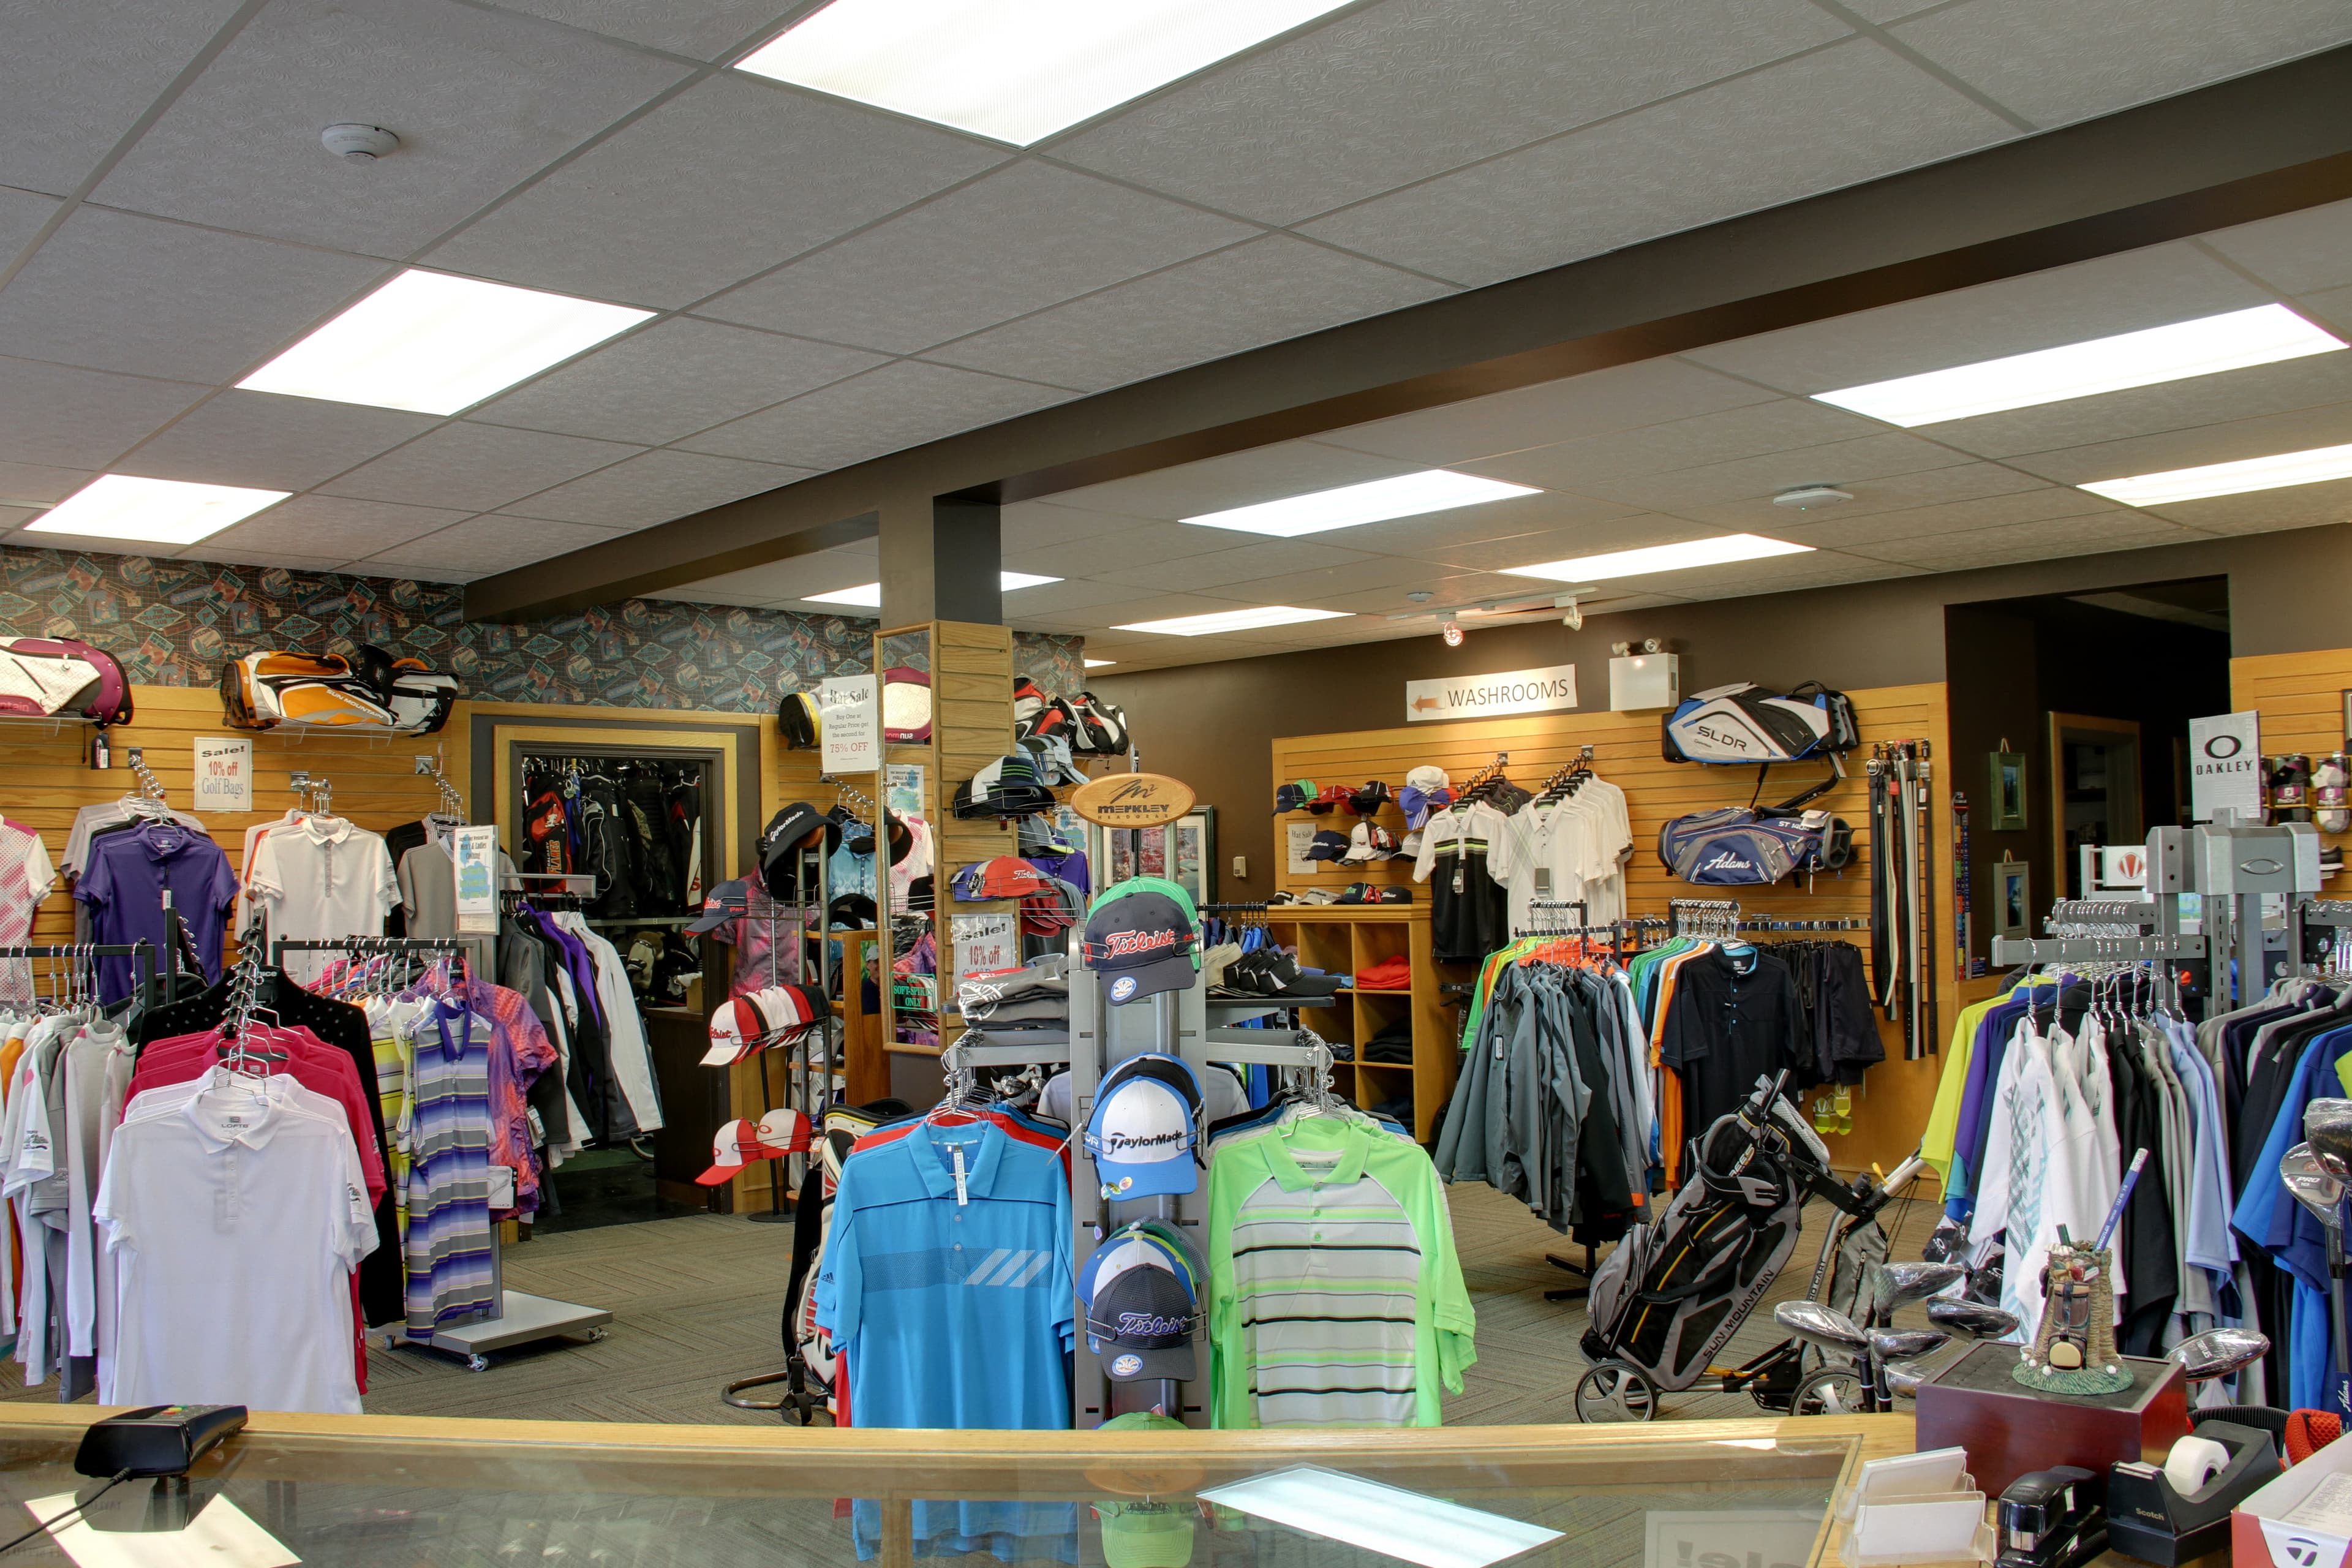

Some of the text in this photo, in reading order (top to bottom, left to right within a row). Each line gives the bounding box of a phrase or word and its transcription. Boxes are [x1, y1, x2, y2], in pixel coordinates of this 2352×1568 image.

[850, 687, 869, 703] Sale
[1448, 679, 1568, 707] WASHROOMS
[326, 688, 384, 719] SUN MOUNTAIN
[830, 742, 869, 753] 75% OFF
[1697, 726, 1747, 752] SLDR
[202, 745, 245, 758] Sale!
[209, 761, 238, 776] 10% off
[2196, 760, 2254, 775] OAKLEY
[202, 777, 244, 799] Golf Bags
[1704, 851, 1751, 870] Adams
[960, 923, 1006, 942] Sale!
[1104, 929, 1176, 960] Titleist
[970, 945, 1001, 966] 10% off
[893, 986, 933, 996] SOFT-SPIKES
[905, 998, 922, 1007] ONLY
[1110, 1130, 1182, 1149] TaylorMade
[1814, 1259, 1826, 1285] CART
[1703, 1268, 1775, 1360] SUN MOUNTAIN
[1115, 1312, 1188, 1336] Titleist
[2136, 1507, 2165, 1521] Scotch
